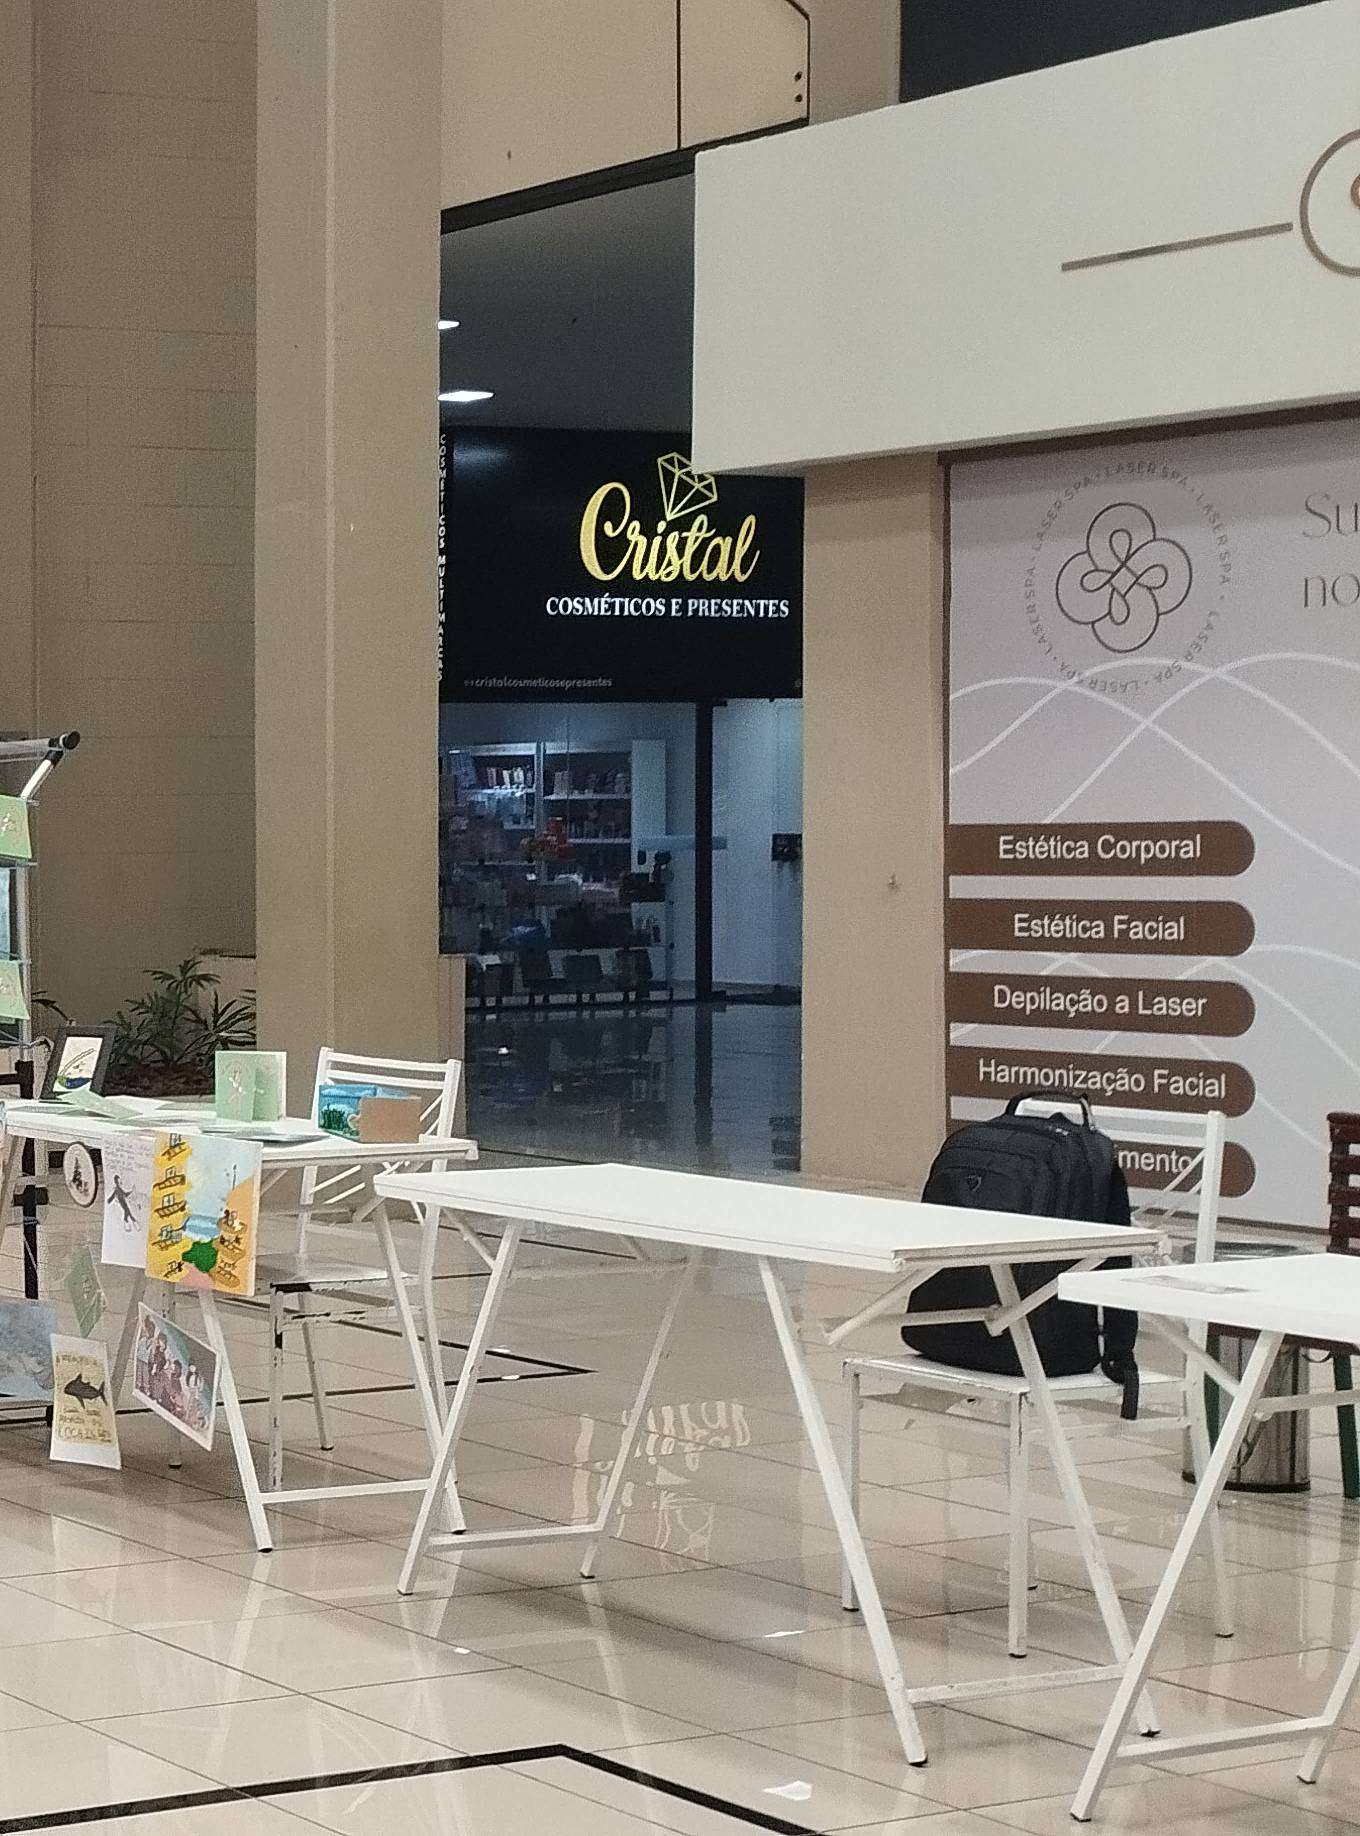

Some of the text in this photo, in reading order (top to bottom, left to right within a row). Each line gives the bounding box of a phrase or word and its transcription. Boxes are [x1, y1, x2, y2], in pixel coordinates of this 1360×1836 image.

[580, 482, 761, 582] Cristal
[546, 593, 790, 619] COSMÉTICOS E PRESENTES
[998, 834, 1202, 865] Estética Corporal
[1013, 914, 1186, 942] Estética Facial
[993, 984, 1208, 1018] Depilação a Laser
[978, 1058, 1226, 1099] Harmonização Facial
